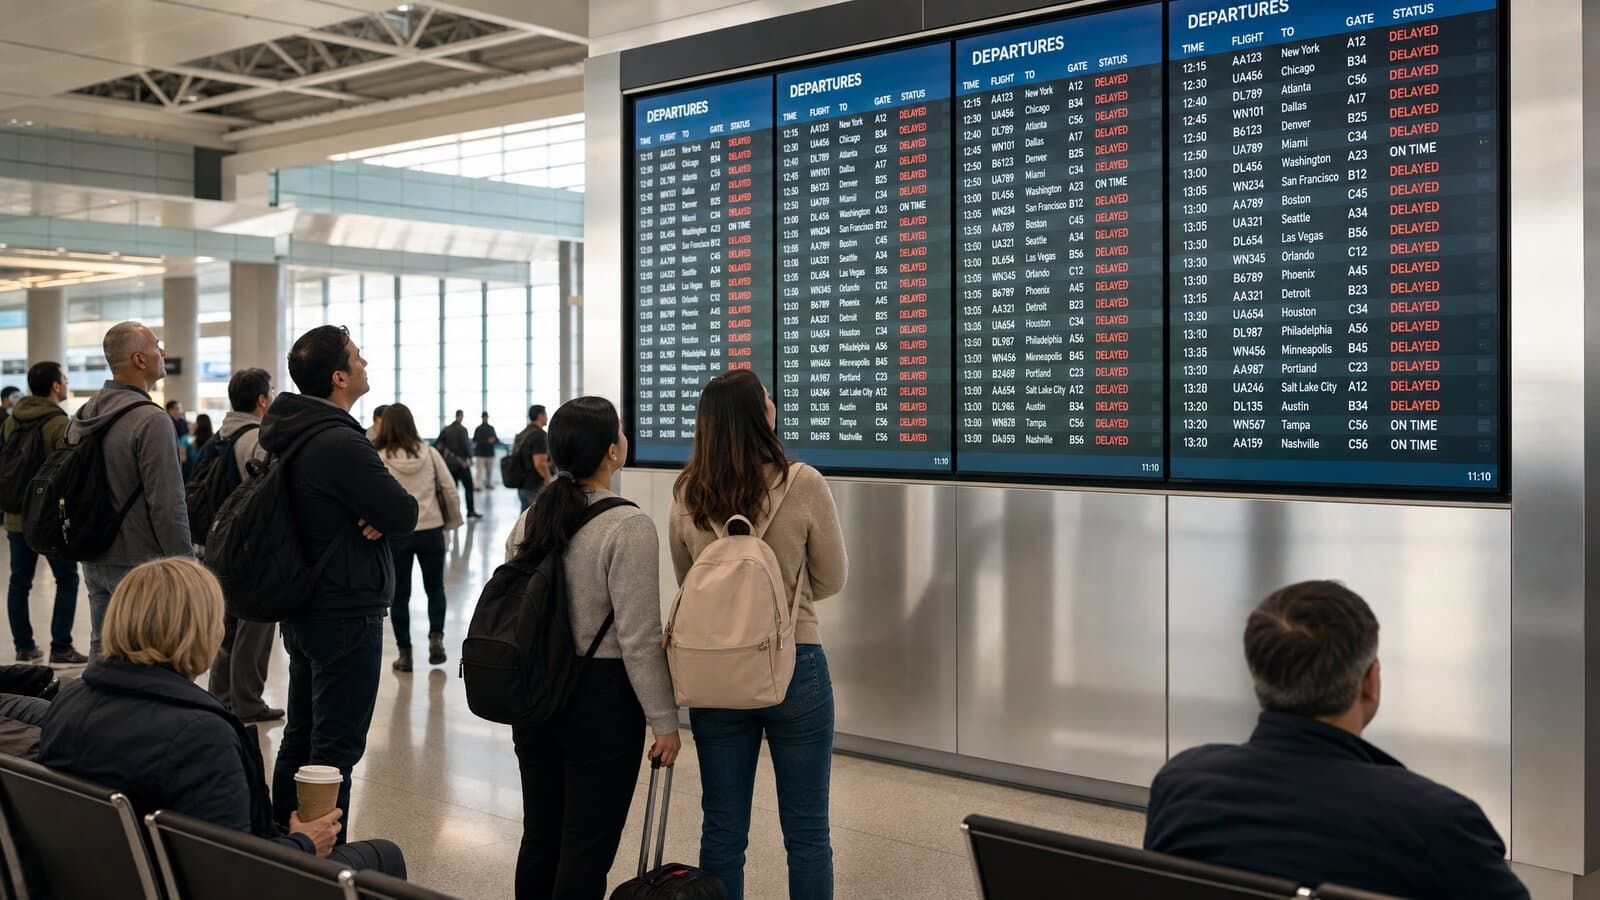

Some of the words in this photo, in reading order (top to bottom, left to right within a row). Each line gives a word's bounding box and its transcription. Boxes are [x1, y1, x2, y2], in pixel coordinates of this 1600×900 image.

[1182, 42, 1204, 53] TIME
[1232, 32, 1264, 46] FLIGHT
[1281, 27, 1294, 37] TO
[1346, 13, 1374, 26] GATE
[1393, 3, 1434, 19] STATUS
[1188, 0, 1289, 29] DEPARTURES
[972, 36, 1064, 66] DEPARTURES
[1183, 61, 1206, 73] 12:15
[1232, 52, 1262, 66] AA123
[1282, 48, 1300, 58] New
[1301, 43, 1320, 54] York
[1347, 36, 1366, 48] A12
[1389, 24, 1438, 42] DELAYED
[962, 80, 980, 90] TIME
[991, 73, 1014, 85] FLIGHT
[1024, 70, 1035, 79] TO
[1068, 61, 1088, 72] GATE
[1099, 54, 1128, 67] STATUS
[1183, 78, 1207, 91] 12:30
[1232, 70, 1262, 83] UA456
[1281, 64, 1315, 76] Chicago
[1348, 54, 1366, 66] B34
[1390, 44, 1438, 61] DELAYED
[790, 72, 862, 98] DEPARTURES
[964, 97, 981, 108] 12:15
[991, 92, 1013, 104] AA123
[1025, 89, 1038, 98] New
[1040, 85, 1053, 95] York
[1068, 80, 1083, 91] A12
[1095, 74, 1128, 87] DELAYED
[1183, 96, 1207, 108] 12:40
[1233, 88, 1262, 101] DL789
[1281, 83, 1311, 94] Atlanta
[1348, 73, 1367, 85] C56
[1390, 64, 1439, 80] DELAYED
[647, 100, 708, 123] DEPARTURES
[783, 112, 797, 120] TIME
[810, 106, 830, 116] FLIGHT
[838, 102, 848, 111] TO
[874, 95, 891, 106] GATE
[901, 89, 925, 100] STATUS
[964, 114, 981, 124] 12:30
[992, 108, 1014, 120] UA456
[1025, 105, 1050, 114] Chicago
[1068, 98, 1083, 108] B34
[1095, 91, 1128, 104] DELAYED
[1183, 114, 1207, 126] 12:45
[1233, 106, 1263, 119] WN101
[1282, 102, 1307, 112] Dallas
[1348, 92, 1366, 104] A17
[1390, 84, 1439, 100] DELAYED
[710, 124, 724, 133] GATE
[784, 128, 798, 138] 12:15
[810, 123, 829, 134] AA123
[851, 117, 863, 126] York
[875, 114, 886, 123] A12
[900, 106, 926, 119] DELAYED
[875, 129, 887, 138] B34
[899, 122, 926, 134] DELAYED
[964, 130, 981, 140] 12:40
[992, 124, 1014, 136] DL789
[1025, 121, 1047, 131] Atlanta
[1068, 114, 1083, 125] C56
[1095, 108, 1128, 121] DELAYED
[728, 136, 751, 147] DELAYED
[1184, 149, 1207, 161] 12:50
[1233, 142, 1263, 155] UA789
[1282, 137, 1308, 149] Miami
[1348, 130, 1367, 142] C34
[1390, 122, 1439, 138] DELAYED
[875, 160, 886, 169] A17
[900, 154, 927, 165] DELAYED
[964, 161, 981, 172] 12:50
[992, 157, 1014, 168] B6123
[1026, 154, 1047, 163] Denver
[1069, 148, 1083, 158] B25
[1095, 142, 1128, 155] DELAYED
[1184, 168, 1207, 179] 13:00
[1233, 161, 1262, 173] DL456
[1282, 155, 1330, 167] Washington
[1348, 150, 1367, 161] A23
[1390, 145, 1406, 156] ON
[1408, 142, 1436, 155] TIME
[728, 179, 751, 189] DELAYED
[964, 193, 981, 204] 13:00
[992, 190, 1014, 200] DL456
[1025, 185, 1062, 196] Washington
[1068, 181, 1084, 192] A23
[1095, 179, 1107, 189] ON
[1108, 176, 1127, 187] TIME
[1184, 185, 1207, 197] 13:05
[1233, 179, 1264, 192] WN234
[1282, 177, 1297, 187] San
[1299, 173, 1339, 184] Francisco
[1348, 168, 1367, 180] B12
[1390, 162, 1439, 176] DELAYED
[875, 205, 887, 214] A23
[900, 202, 909, 211] ON
[910, 200, 926, 209] TIME
[992, 271, 1016, 281] WN345
[1026, 268, 1050, 278] Orlando
[1069, 266, 1084, 276] C12
[1096, 262, 1128, 274] DELAYED
[992, 304, 1014, 313] AA321
[1026, 302, 1047, 312] Detroit
[1070, 300, 1084, 309] B23
[1096, 298, 1128, 308] DELAYED
[1233, 346, 1266, 356] WN456
[1282, 344, 1332, 356] Minneapolis
[1348, 342, 1368, 353] B45
[1390, 340, 1440, 352] DELAYED
[1026, 402, 1045, 410] Austin
[1070, 402, 1084, 411] B34
[1096, 402, 1128, 411] DELAYED
[1184, 401, 1207, 411] 13:20
[1234, 401, 1263, 411] DL135
[1282, 401, 1309, 411] Austin
[1348, 400, 1368, 411] B34
[1390, 400, 1440, 411] DELAYED
[876, 433, 888, 441] C56
[900, 433, 927, 442] DELAYED
[1184, 419, 1207, 429] 13:20
[1233, 419, 1265, 430] WN567
[1281, 420, 1310, 432] Tampa
[1348, 420, 1368, 430] C56
[1391, 420, 1407, 430] ON
[1410, 420, 1437, 430] TIME
[1184, 437, 1208, 447] 13:20
[1233, 438, 1263, 448] AA159
[1282, 438, 1320, 448] Nashville
[1348, 439, 1368, 449] C56
[1391, 439, 1407, 450] ON
[1410, 440, 1437, 450] TIME
[1468, 472, 1491, 481] 11:10
